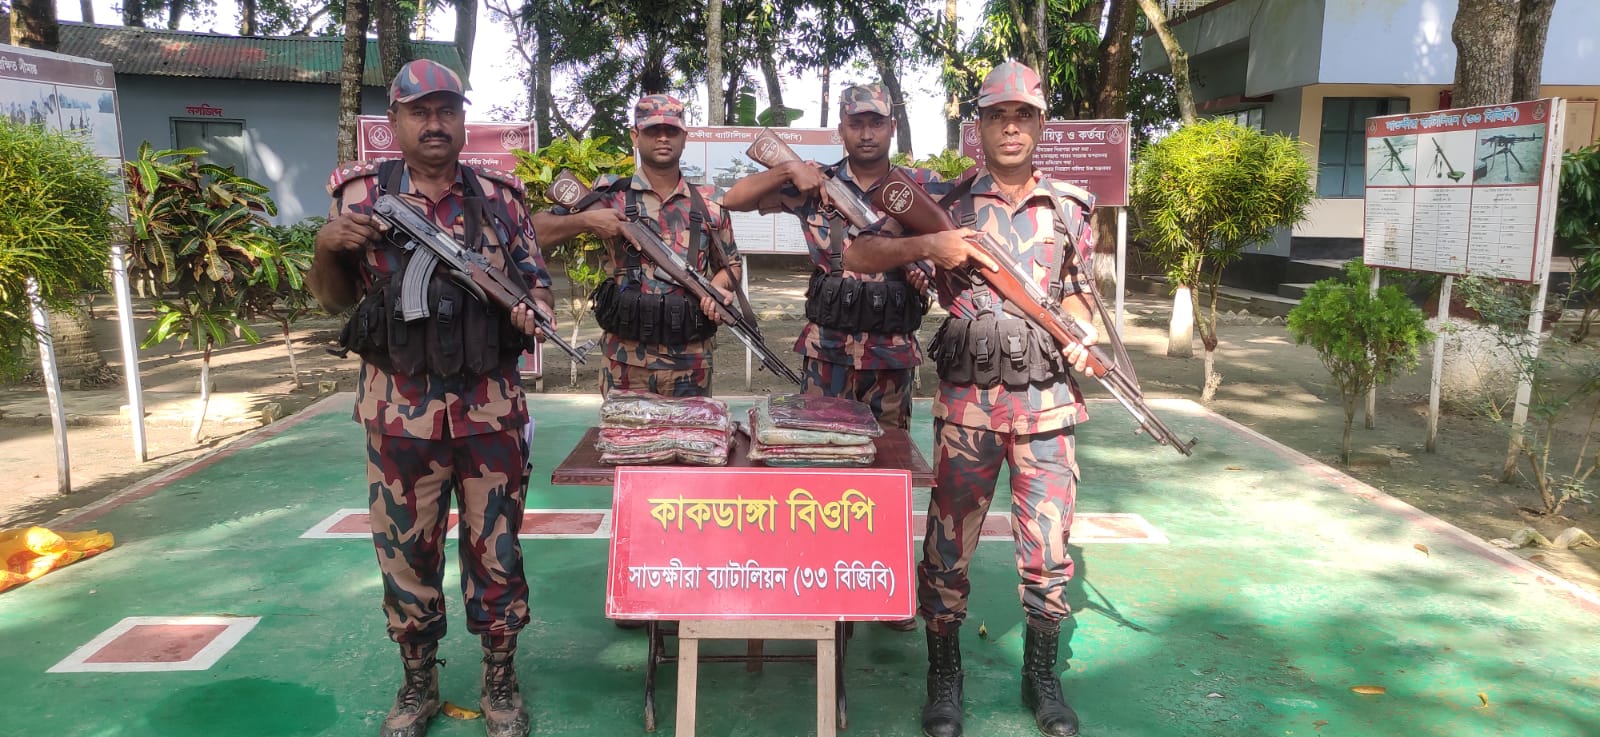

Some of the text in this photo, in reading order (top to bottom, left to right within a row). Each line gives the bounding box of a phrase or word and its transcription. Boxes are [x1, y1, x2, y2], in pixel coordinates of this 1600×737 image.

[1040, 127, 1106, 144] ায়িত্ব ও কর্তব্য
[648, 488, 876, 533] কাকডাঙ্গা বিওপি
[628, 557, 896, 597] সাতক্ষীরা ব্যাটালিয়ন (৩৩ বিজিবি)
